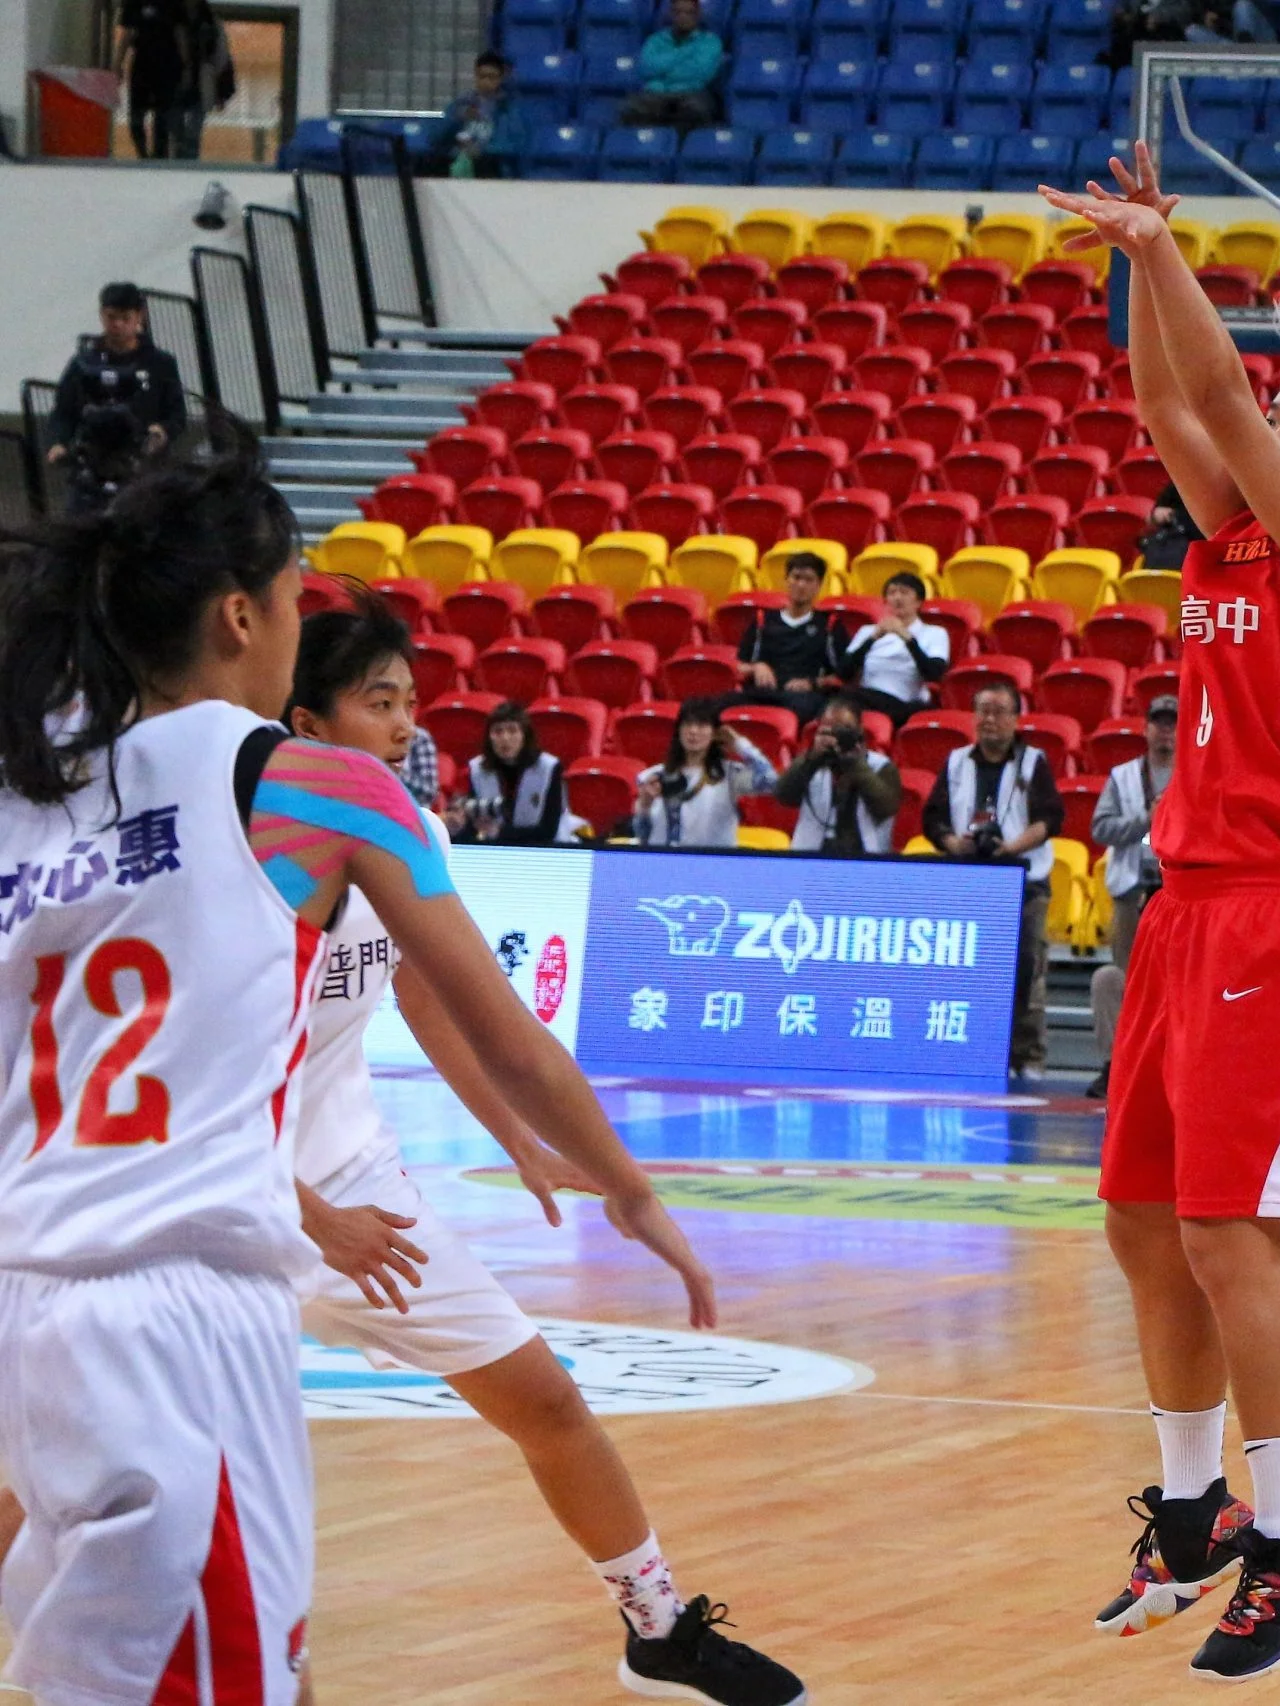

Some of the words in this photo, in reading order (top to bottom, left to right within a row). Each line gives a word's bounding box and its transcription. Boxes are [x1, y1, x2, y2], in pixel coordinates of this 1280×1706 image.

[1180, 594, 1260, 645] 高中
[318, 936, 402, 1002] 普門
[734, 899, 978, 974] ZOJIRUSHI
[628, 986, 972, 1044] 象印保溫瓶
[25, 936, 173, 1162] 12
